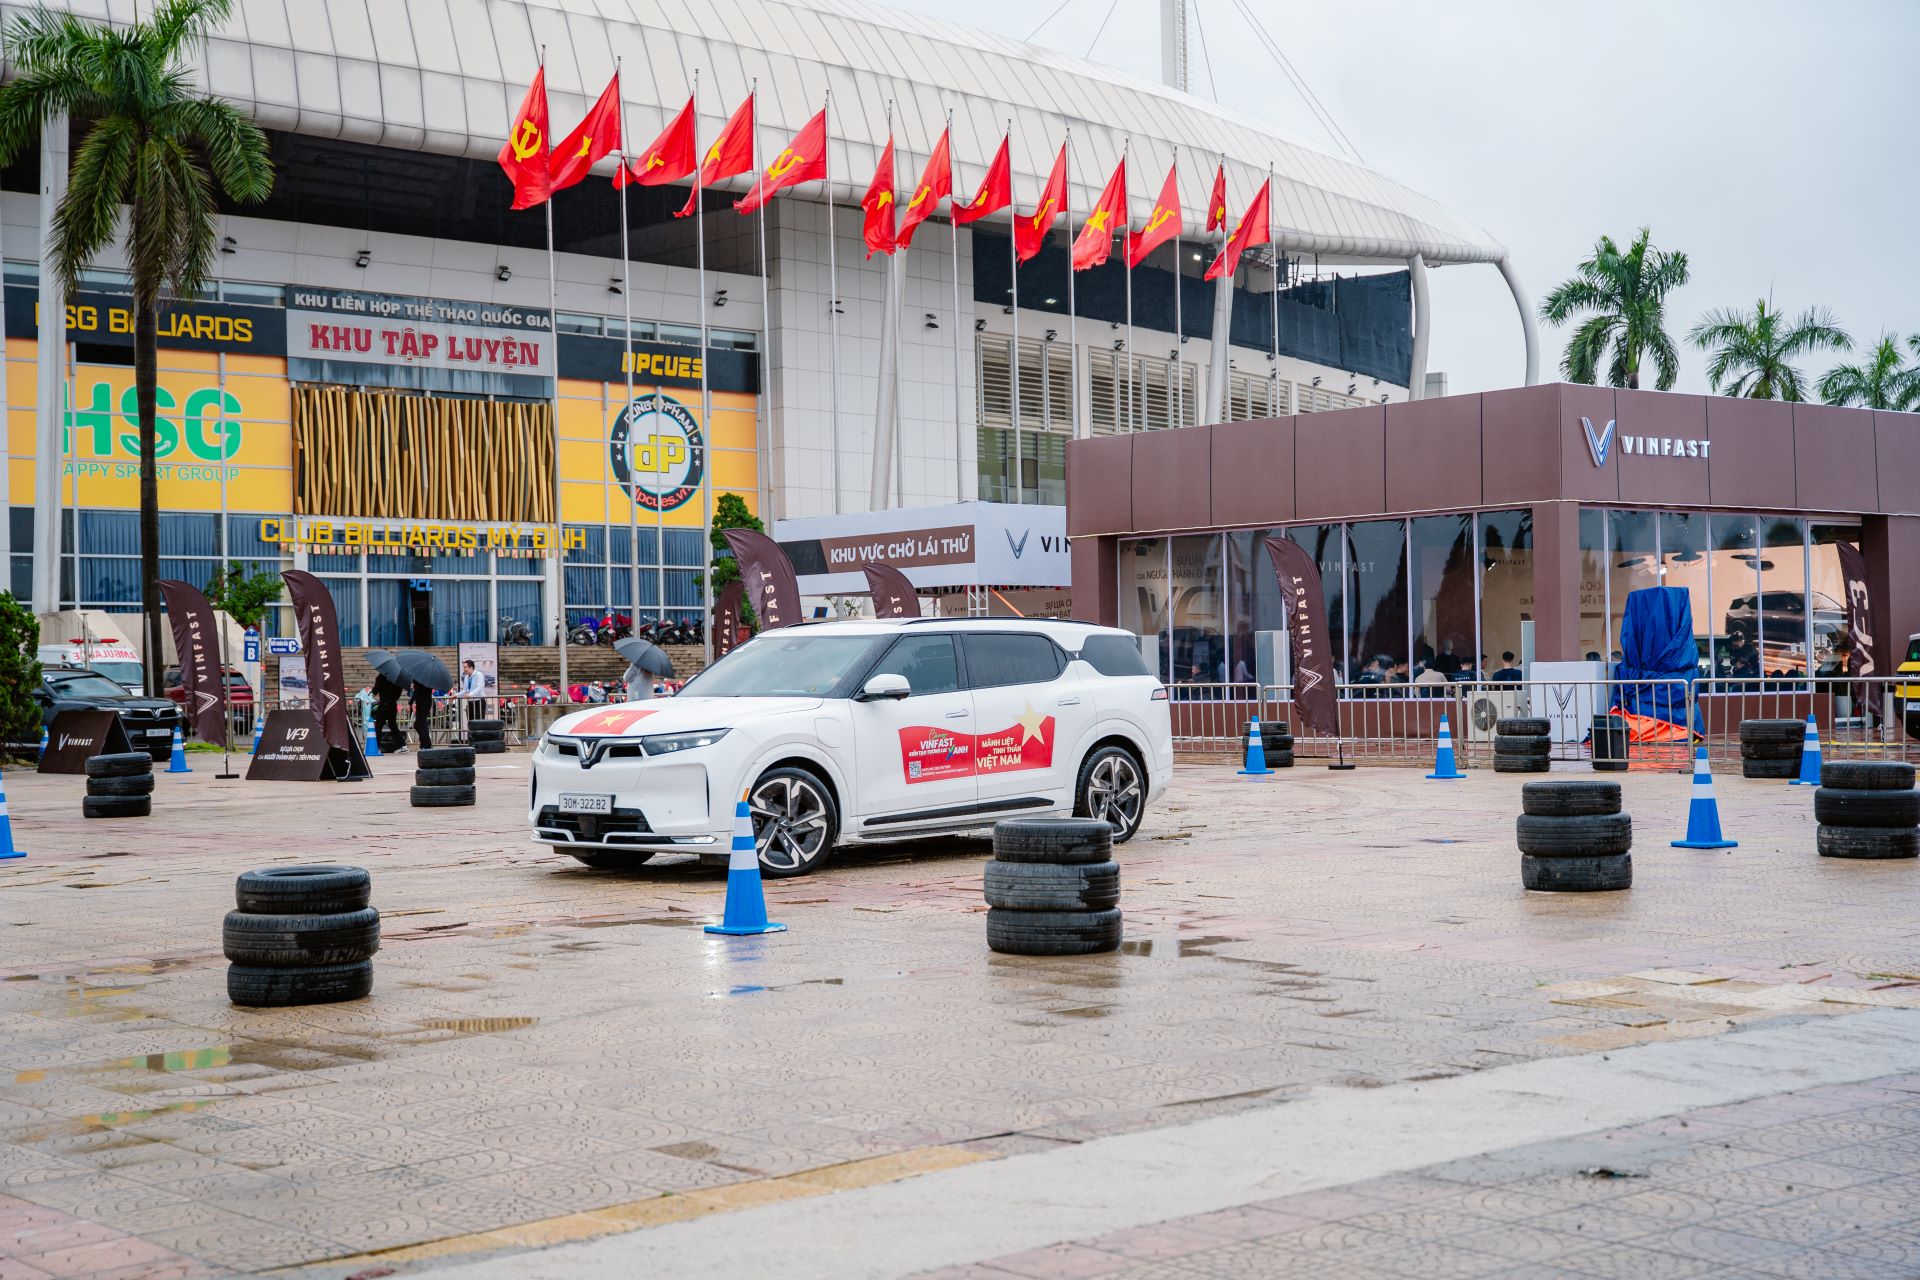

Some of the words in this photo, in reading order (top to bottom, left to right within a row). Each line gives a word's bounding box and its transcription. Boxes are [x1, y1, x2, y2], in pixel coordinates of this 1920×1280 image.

[295, 293, 327, 308] KHU
[332, 296, 366, 312] LIÊN
[370, 300, 400, 317] HỢP
[405, 299, 432, 318] THỂ
[437, 306, 477, 321] THAO
[481, 308, 523, 325] QUỐC
[526, 314, 551, 328] GIA
[310, 324, 372, 353] KHU
[380, 327, 439, 361] TẬP
[447, 335, 540, 369] LUYỆN
[64, 380, 242, 461] HSG
[1621, 435, 1711, 458] VINFAST
[64, 463, 110, 478] APPY
[177, 465, 240, 481] GROUP
[261, 519, 333, 544] CLUB
[345, 522, 477, 549] BILLIARDS
[487, 522, 523, 548] MỸ
[831, 547, 856, 563] KHU
[859, 543, 885, 563] VỰC
[888, 538, 915, 559] CHỜ
[918, 536, 939, 556] LÁI
[941, 533, 970, 554] THỬ
[1292, 576, 1313, 658] VINFAST
[186, 611, 208, 683] VINFAST
[247, 647, 256, 660] B
[288, 640, 297, 653] C
[310, 604, 331, 681] VINFAST
[67, 738, 93, 747] VINFAST
[286, 728, 310, 741] VF9
[920, 738, 954, 750] VINFAST
[976, 753, 999, 770] VIỆT
[1000, 752, 1022, 766] NAM
